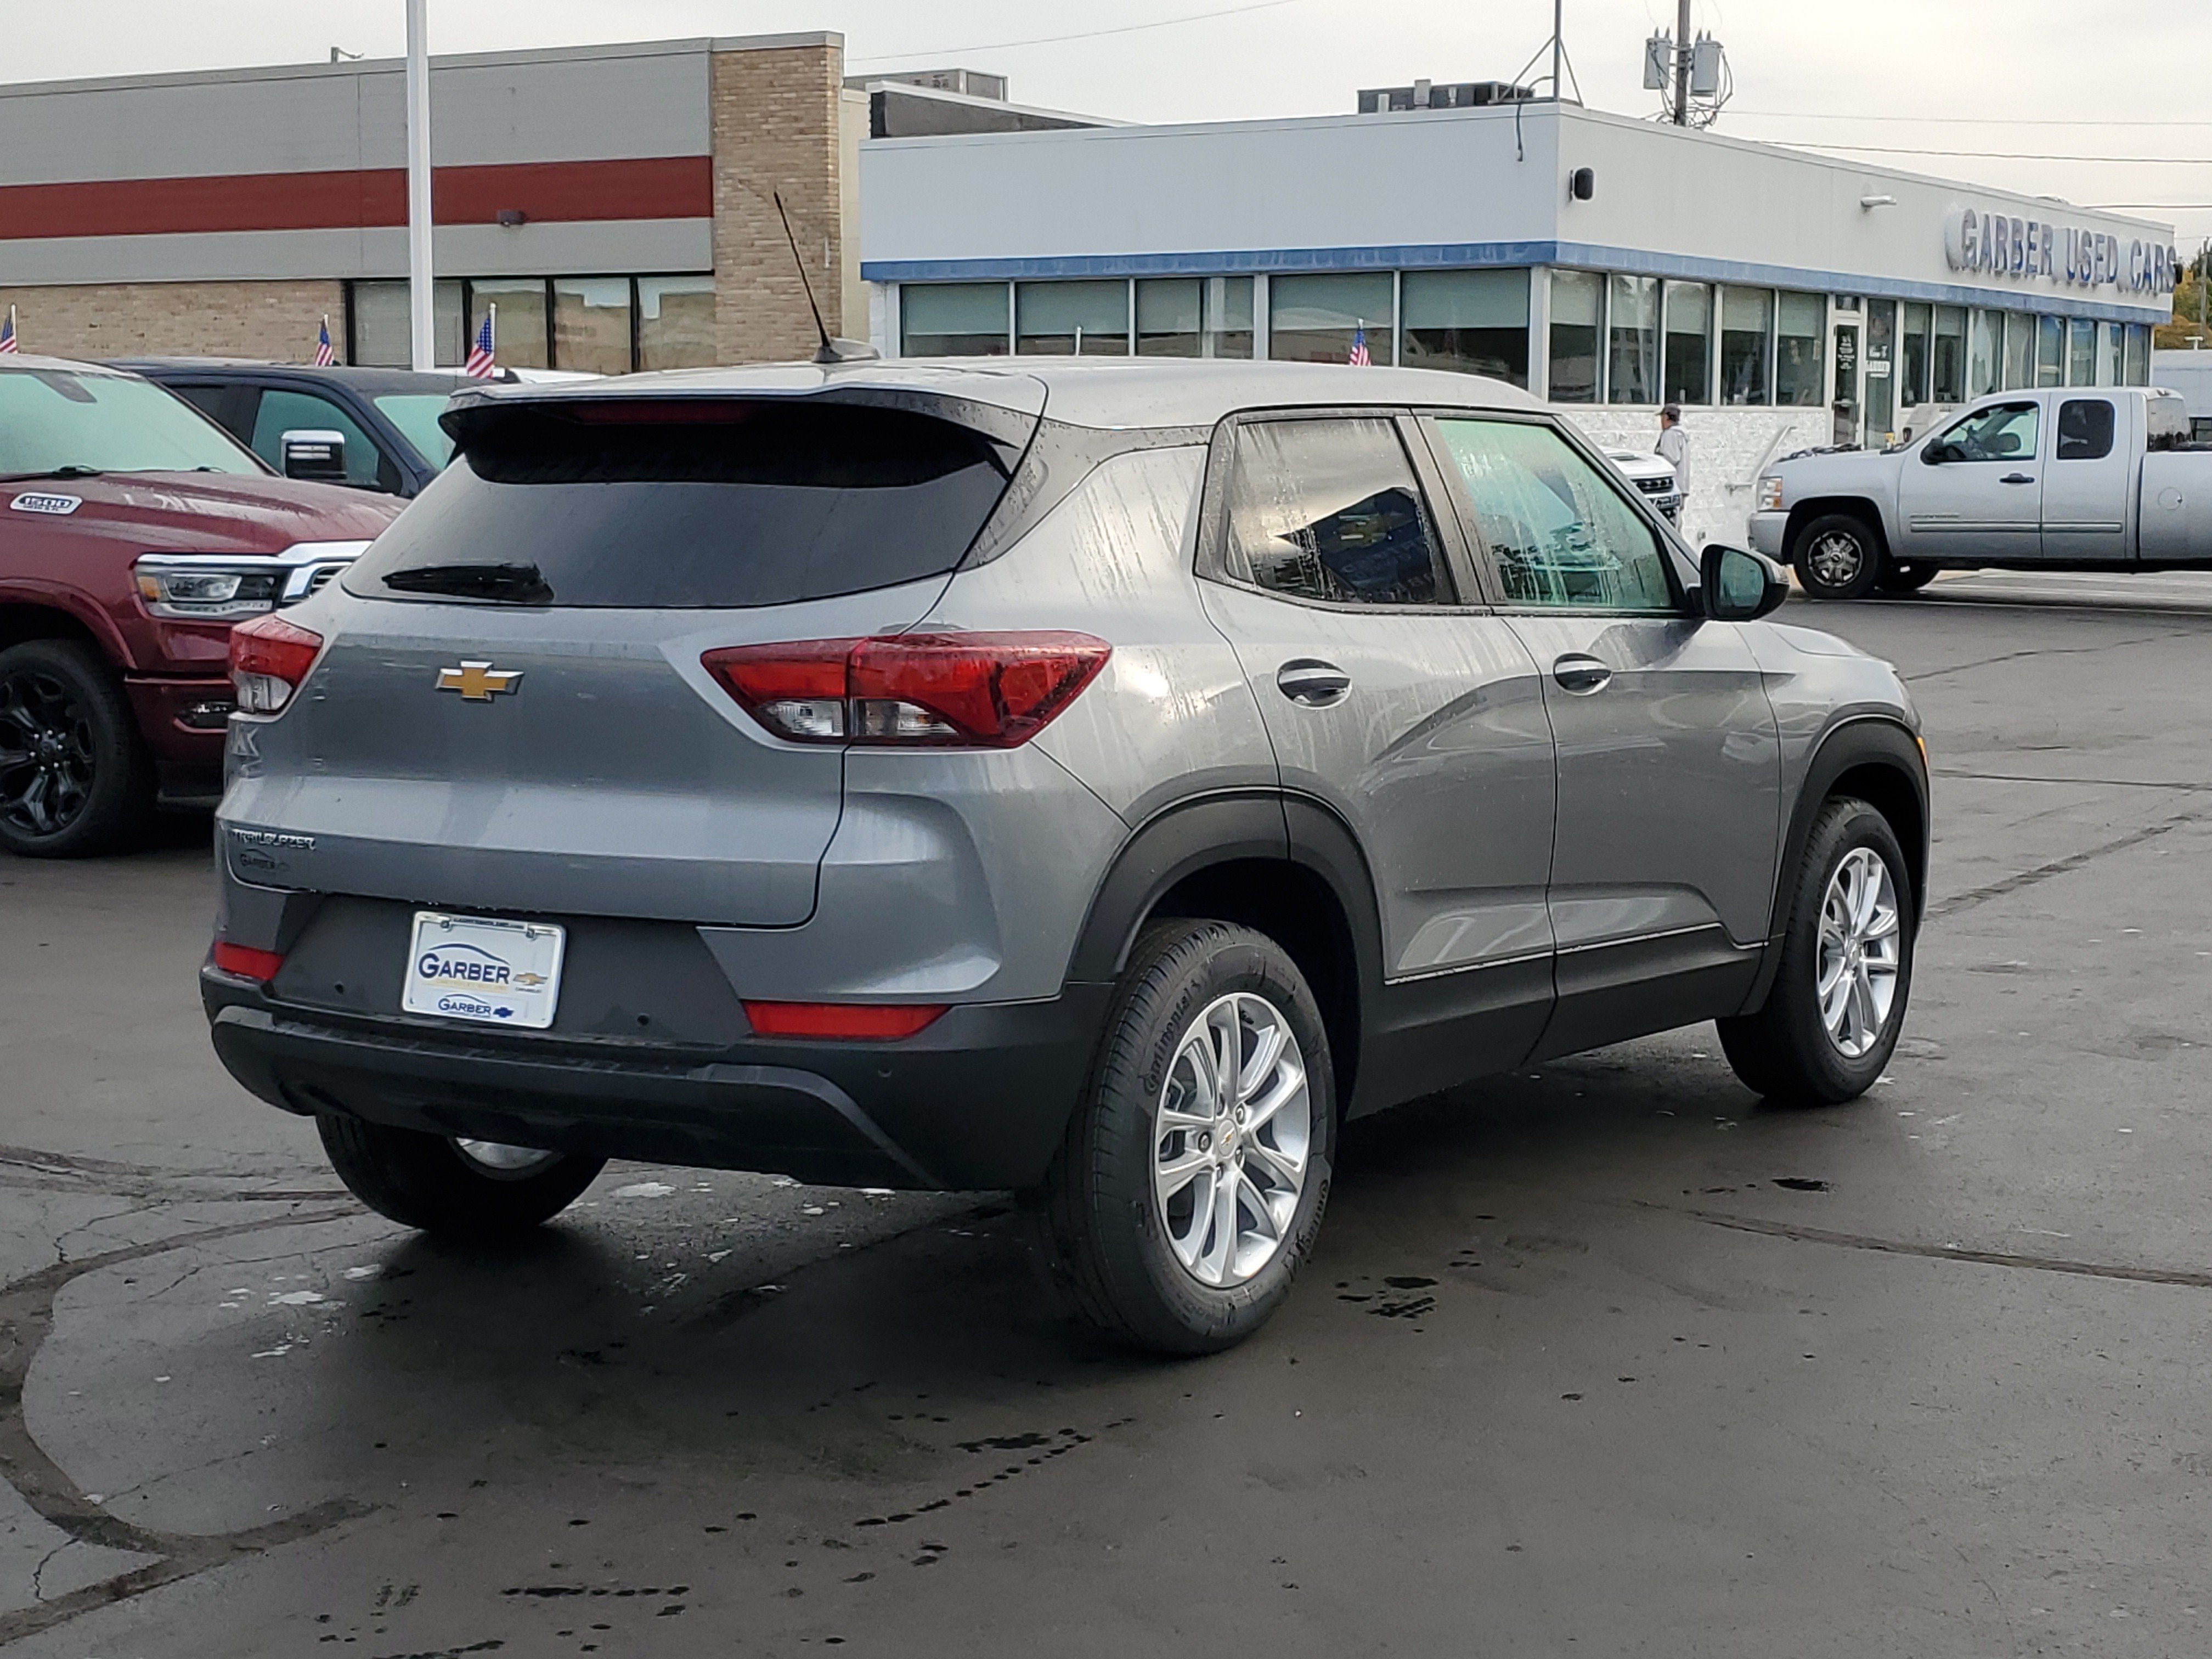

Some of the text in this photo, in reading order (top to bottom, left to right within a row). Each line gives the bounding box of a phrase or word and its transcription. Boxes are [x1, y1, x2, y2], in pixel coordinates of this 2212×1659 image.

[1961, 208, 2176, 293] GARBER USED CARS
[25, 497, 71, 508] 1500
[232, 828, 317, 851] TRAILBLAZER
[418, 952, 511, 984] GARBER
[438, 997, 492, 1015] GARBER
